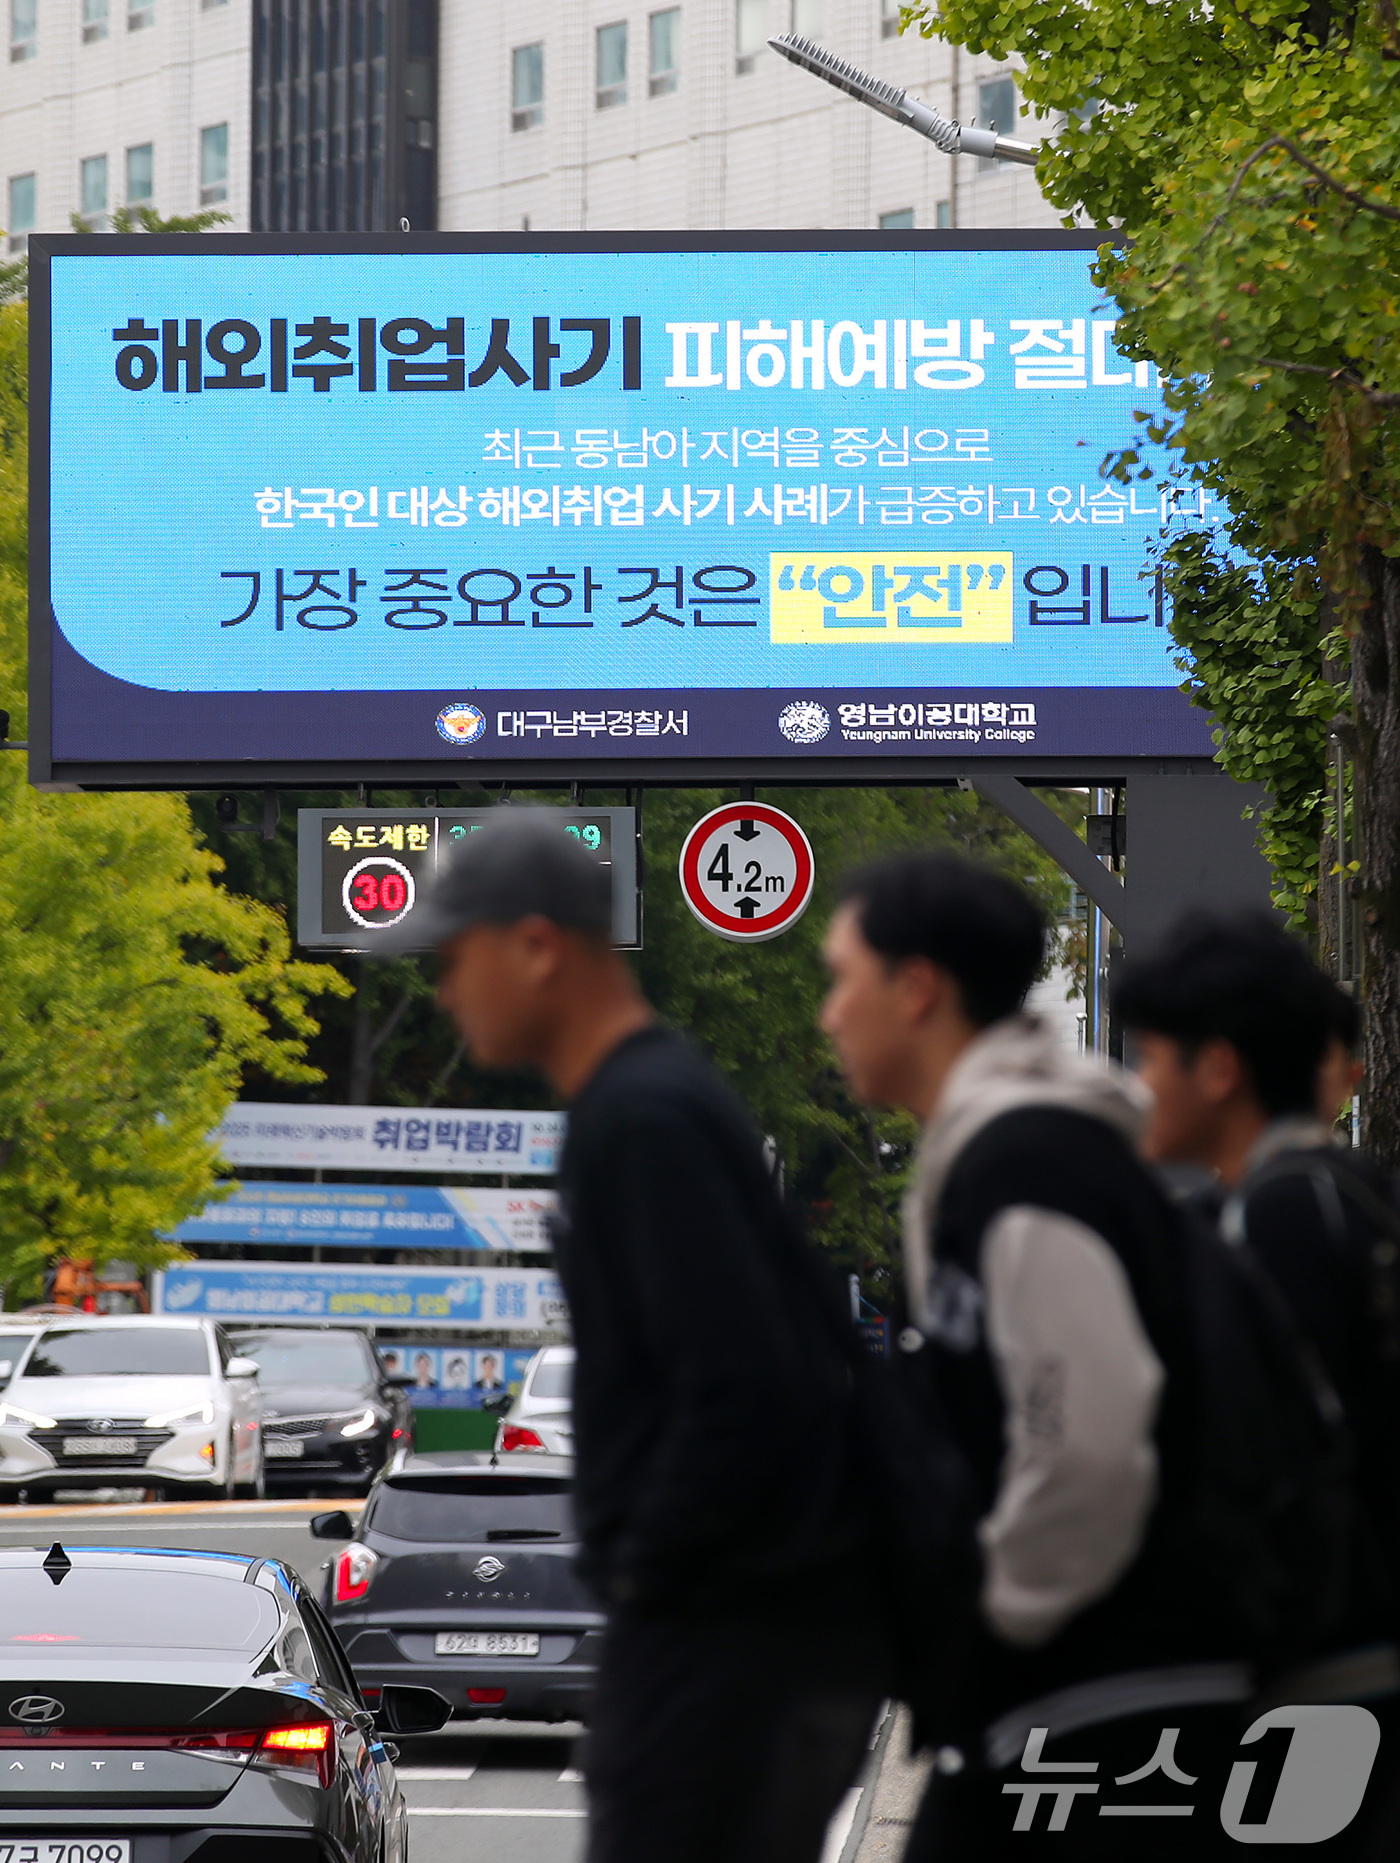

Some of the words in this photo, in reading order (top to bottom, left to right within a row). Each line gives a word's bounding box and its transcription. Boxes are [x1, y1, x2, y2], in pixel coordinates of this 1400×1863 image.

[112, 316, 641, 393] 해외취업사기
[664, 319, 994, 390] 피해예방
[482, 428, 564, 468] 최근
[570, 427, 696, 468] 동남아
[700, 426, 825, 468] 지역을
[830, 425, 994, 467] 중심으로
[254, 486, 378, 527] 한국인
[388, 486, 472, 526] 대상
[478, 485, 644, 526] 해외취업
[651, 484, 734, 525] 사기
[743, 483, 871, 525] 사례가
[875, 484, 1041, 525] 급증하고
[220, 567, 366, 630] 가장
[380, 567, 603, 630] 중요한
[618, 565, 761, 629] 것은
[1023, 563, 1163, 627] 입니
[497, 710, 688, 738] 대구남부경찰서
[837, 702, 1037, 727] 영남이공대학교
[841, 728, 910, 743] Yeungnam
[915, 728, 981, 743] University
[984, 728, 1036, 743] College
[328, 824, 430, 850] 속도제한
[707, 843, 785, 893] 4.2m
[353, 873, 406, 911] 30
[373, 1117, 523, 1153] 취업박람회
[48, 1844, 123, 1863] 7099
